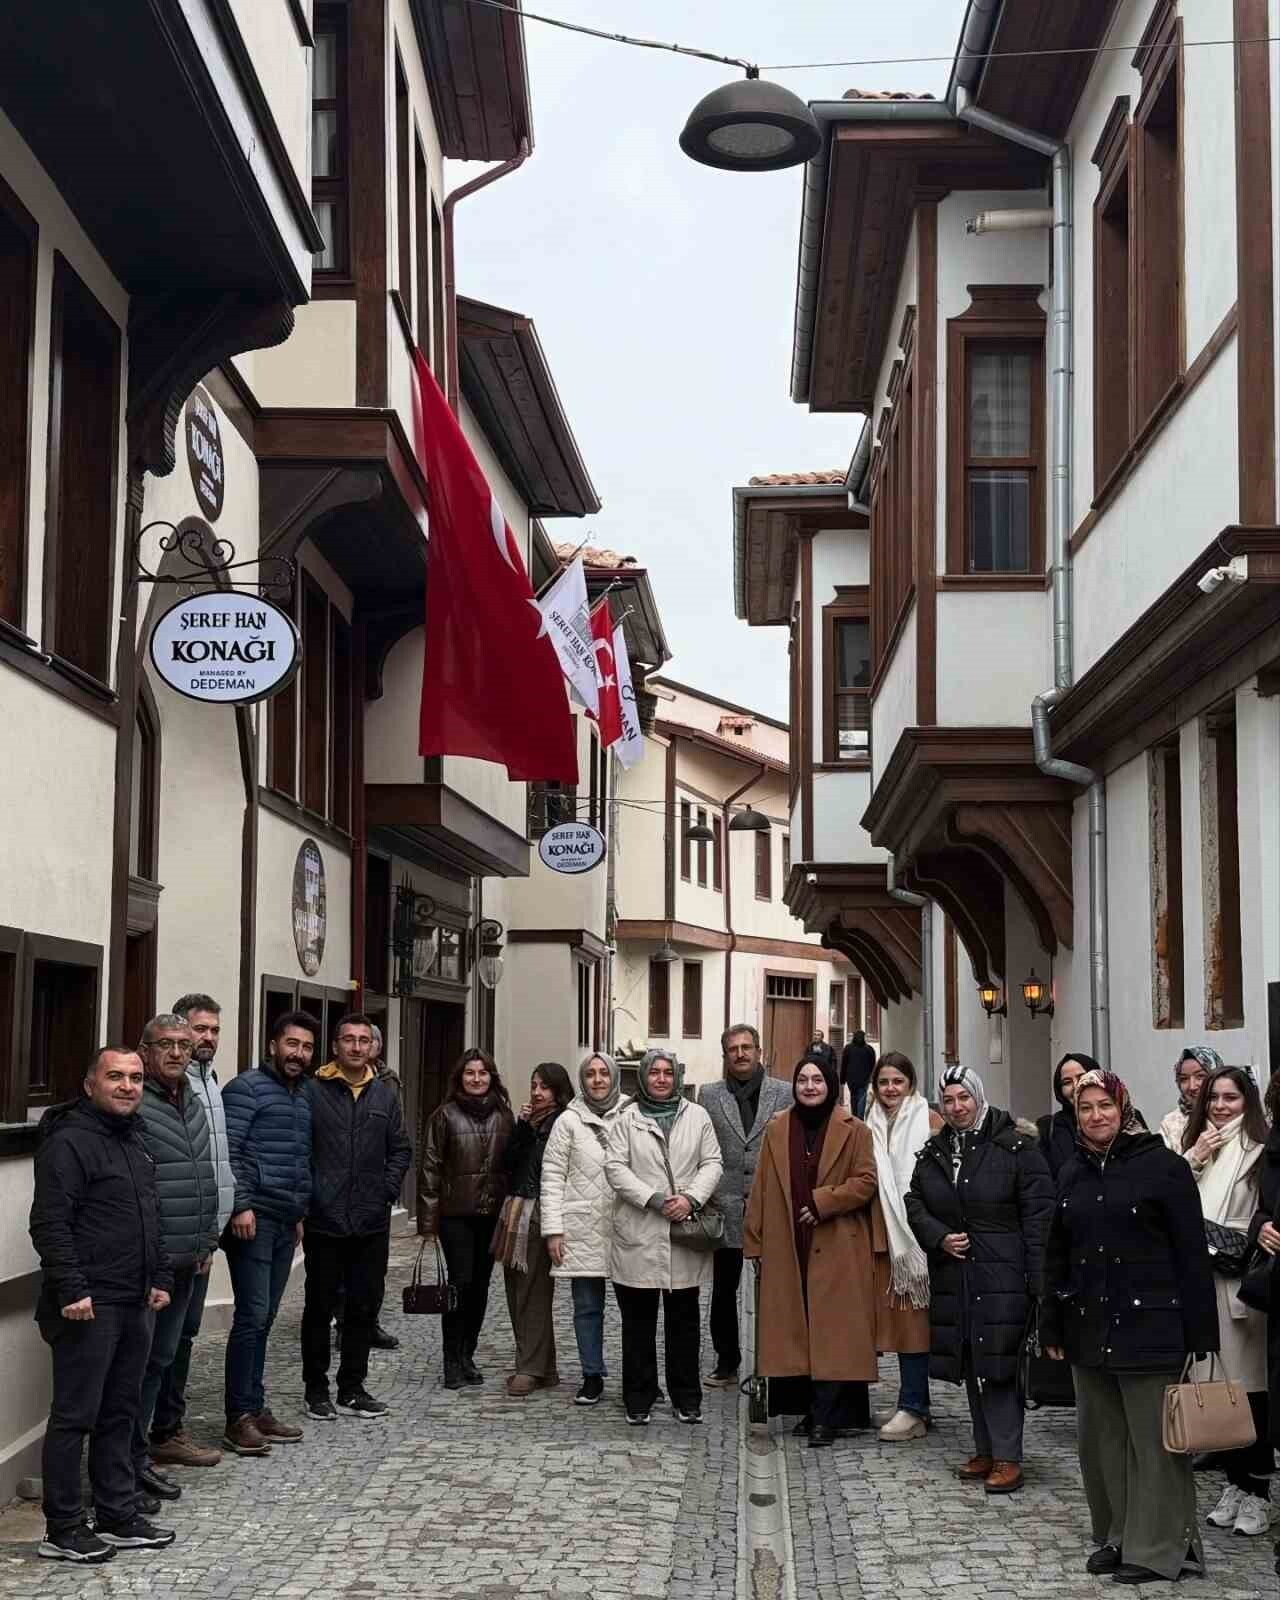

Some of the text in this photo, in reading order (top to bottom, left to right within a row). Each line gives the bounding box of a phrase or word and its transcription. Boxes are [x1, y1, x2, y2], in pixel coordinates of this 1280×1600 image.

[180, 612, 267, 631] ŞEREF HAN
[171, 635, 276, 664] KONAĞI
[190, 678, 255, 690] DEDEMAN
[548, 842, 595, 856] KONAĞI
